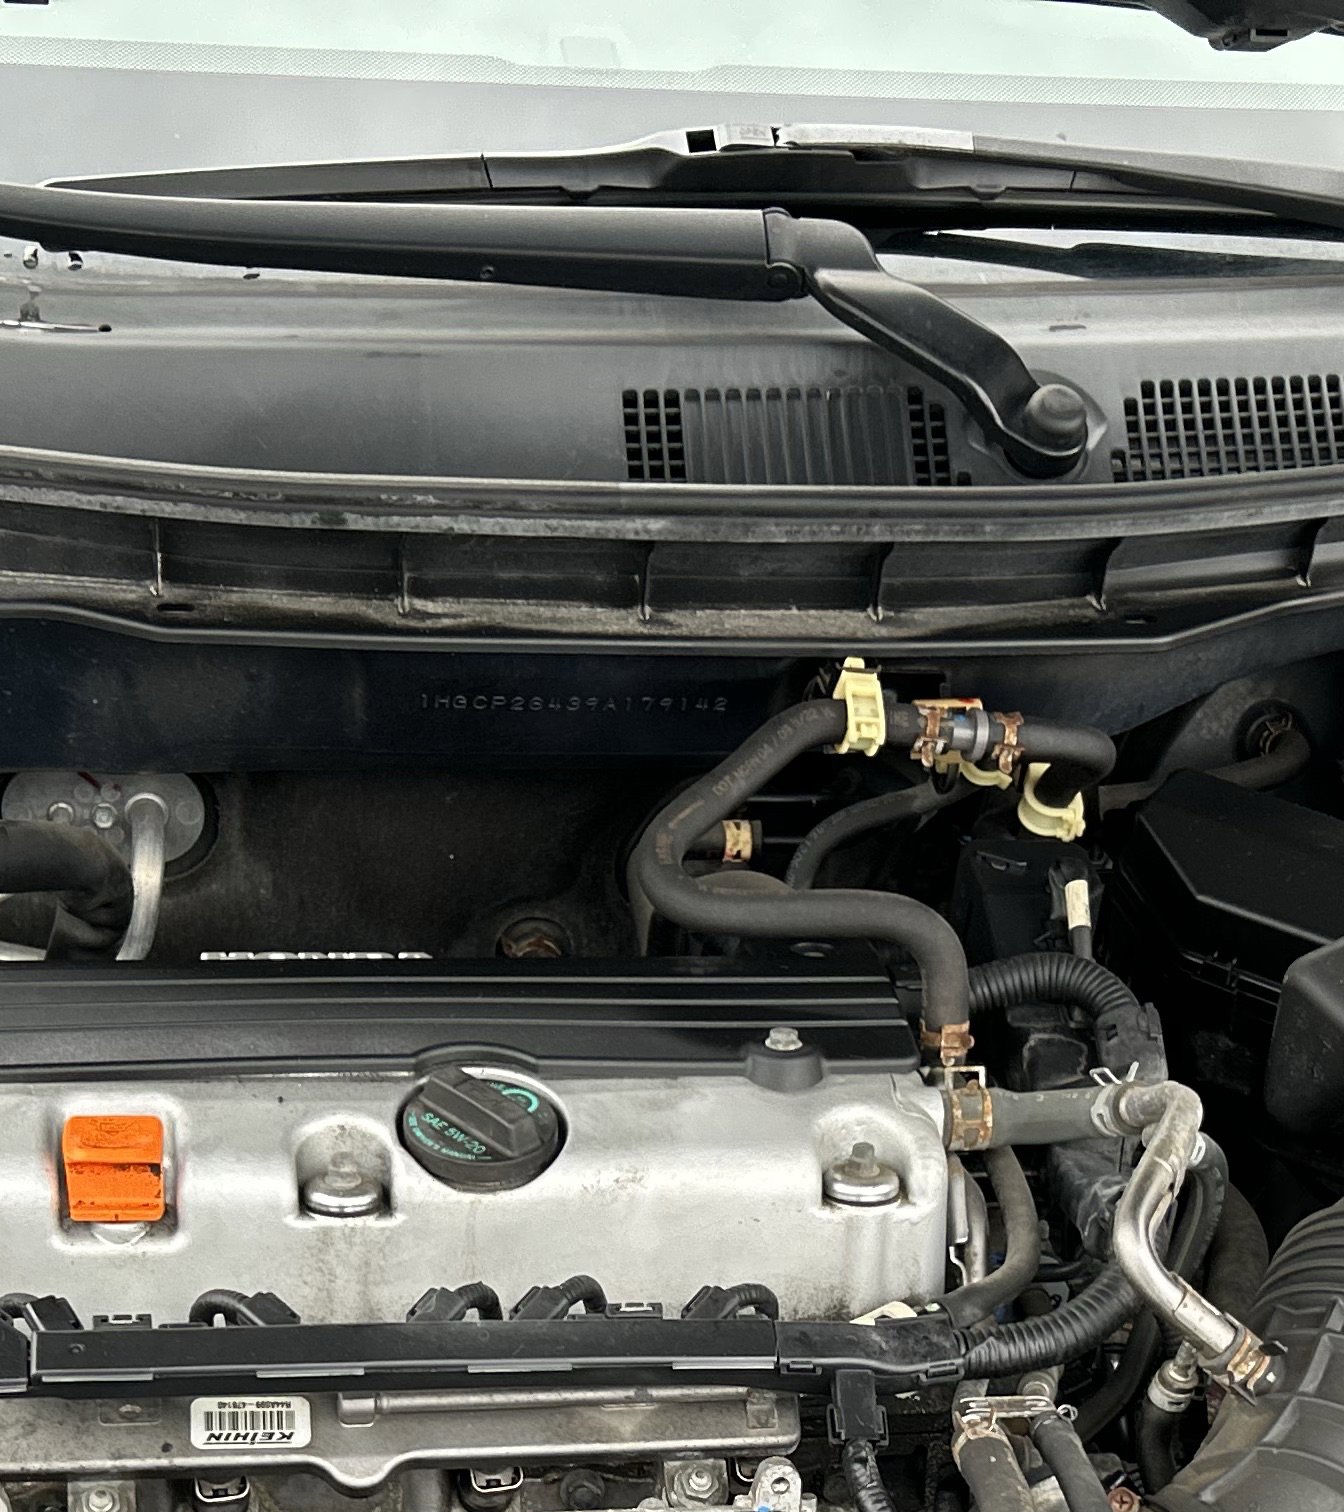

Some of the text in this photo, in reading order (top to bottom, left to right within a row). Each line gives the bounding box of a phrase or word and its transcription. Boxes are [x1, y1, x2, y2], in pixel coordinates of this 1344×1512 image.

[421, 1112, 487, 1154] SAE 5W-20
[205, 1431, 295, 1443] KEIHIN
